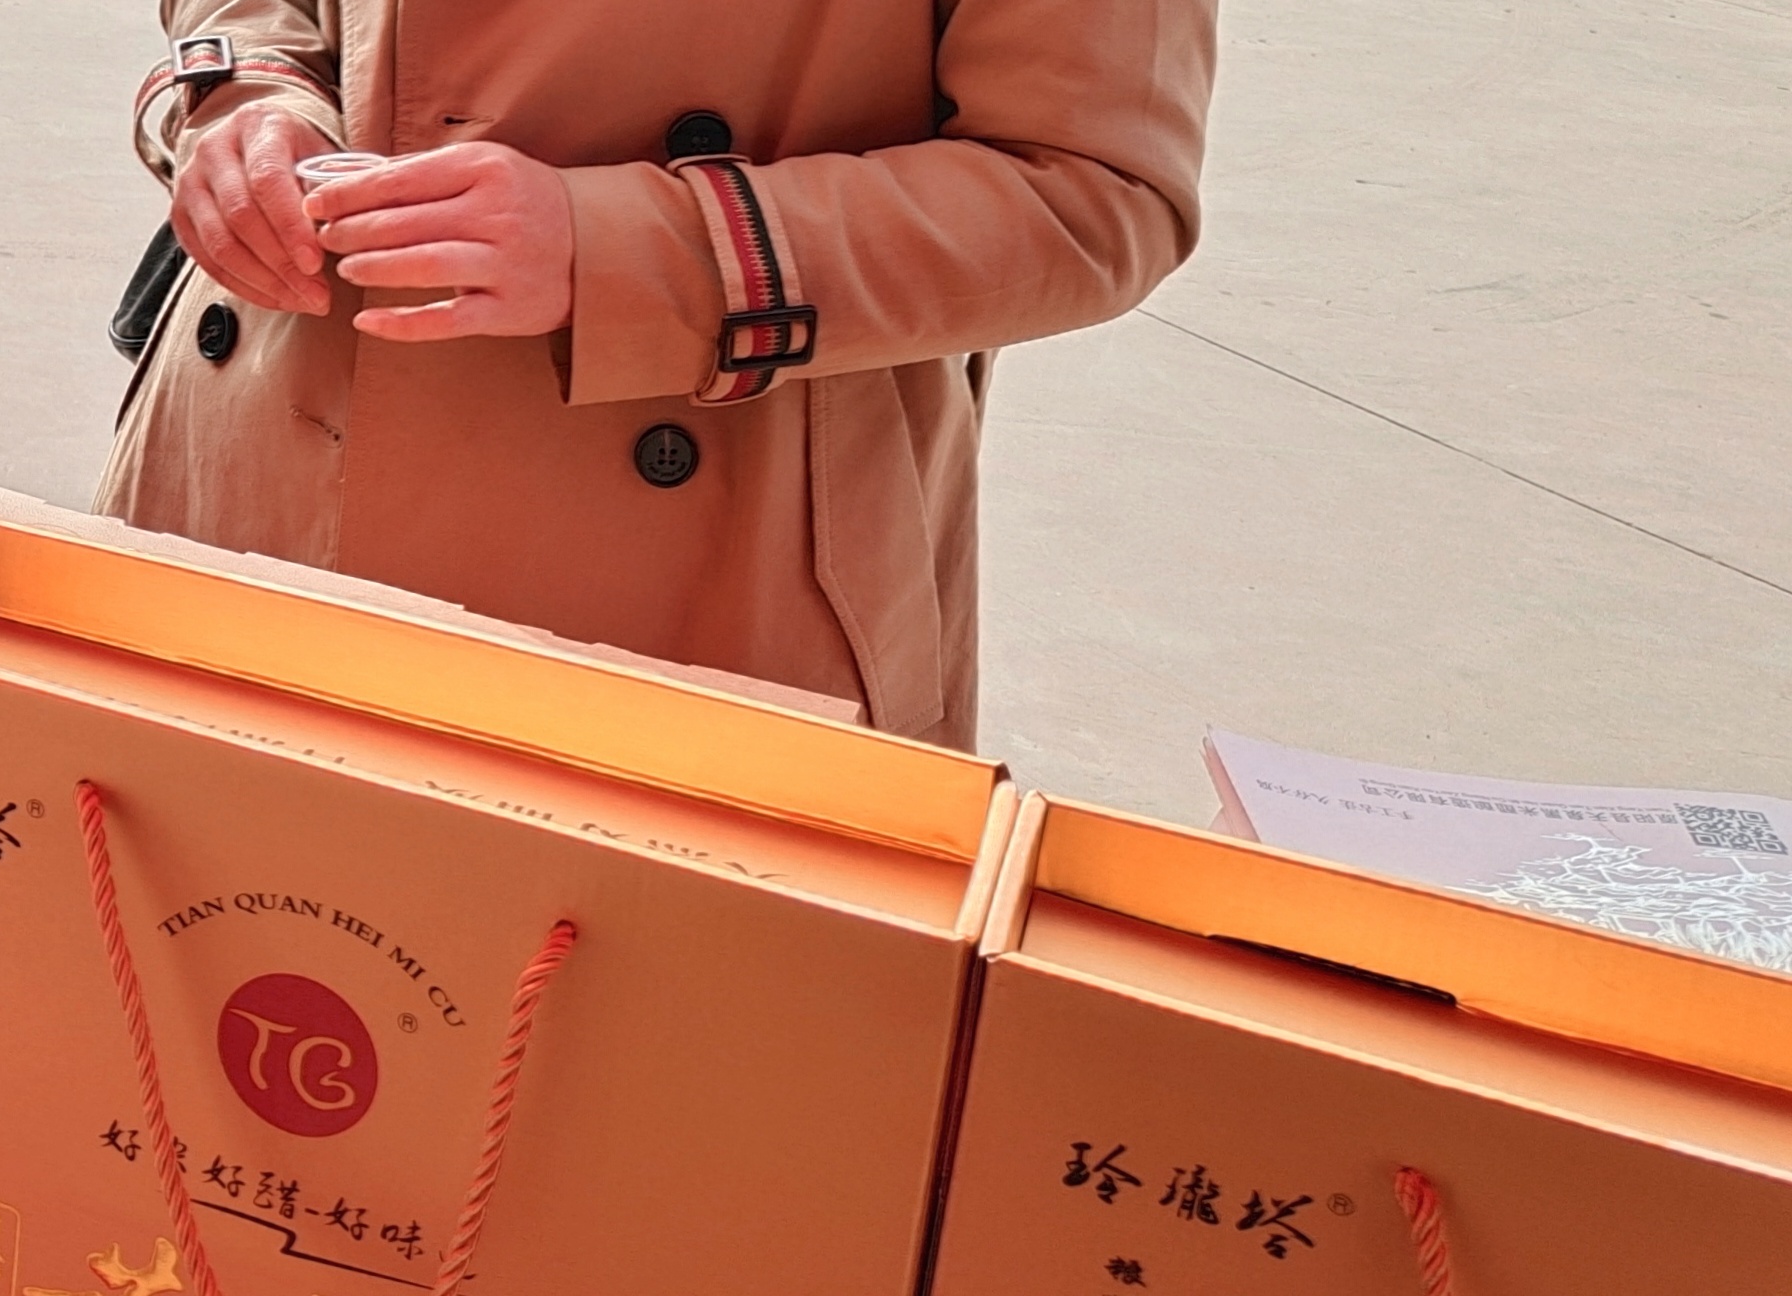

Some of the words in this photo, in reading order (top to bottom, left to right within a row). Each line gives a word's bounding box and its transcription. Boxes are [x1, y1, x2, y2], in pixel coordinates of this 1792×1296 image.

[157, 897, 226, 938] TIAN
[233, 893, 324, 919] QUAN
[330, 909, 385, 948] HEI
[388, 946, 427, 982] MI
[427, 985, 467, 1029] CU
